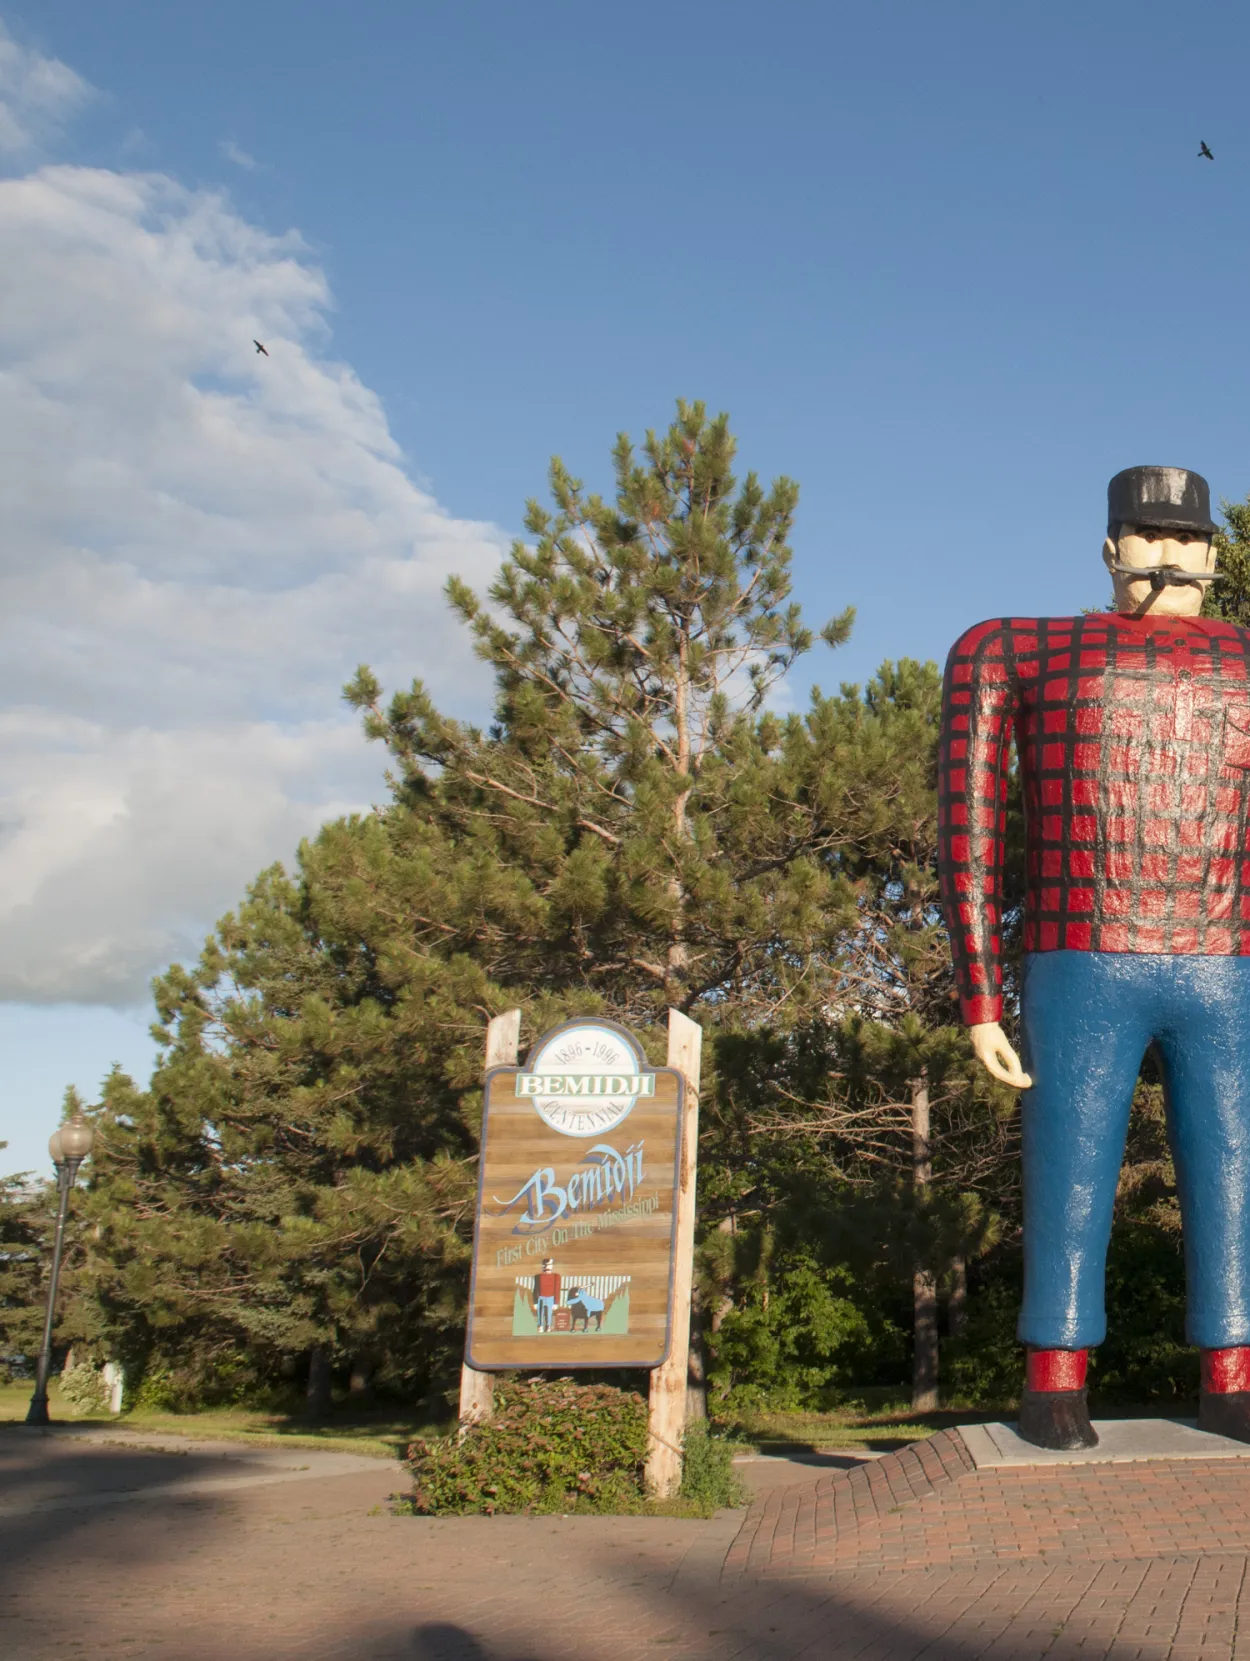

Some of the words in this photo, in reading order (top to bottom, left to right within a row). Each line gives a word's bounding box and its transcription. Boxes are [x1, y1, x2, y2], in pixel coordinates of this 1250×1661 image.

[554, 1042, 583, 1065] 1896
[592, 1042, 620, 1065] 1996
[519, 1076, 651, 1095] BEMIDJI
[543, 1100, 625, 1131] CENTENNIAL
[492, 1139, 647, 1224] Bemidji
[496, 1244, 522, 1268] First
[526, 1235, 549, 1257] City
[552, 1227, 568, 1247] On
[571, 1218, 593, 1239] The
[597, 1191, 659, 1230] Mississippi
